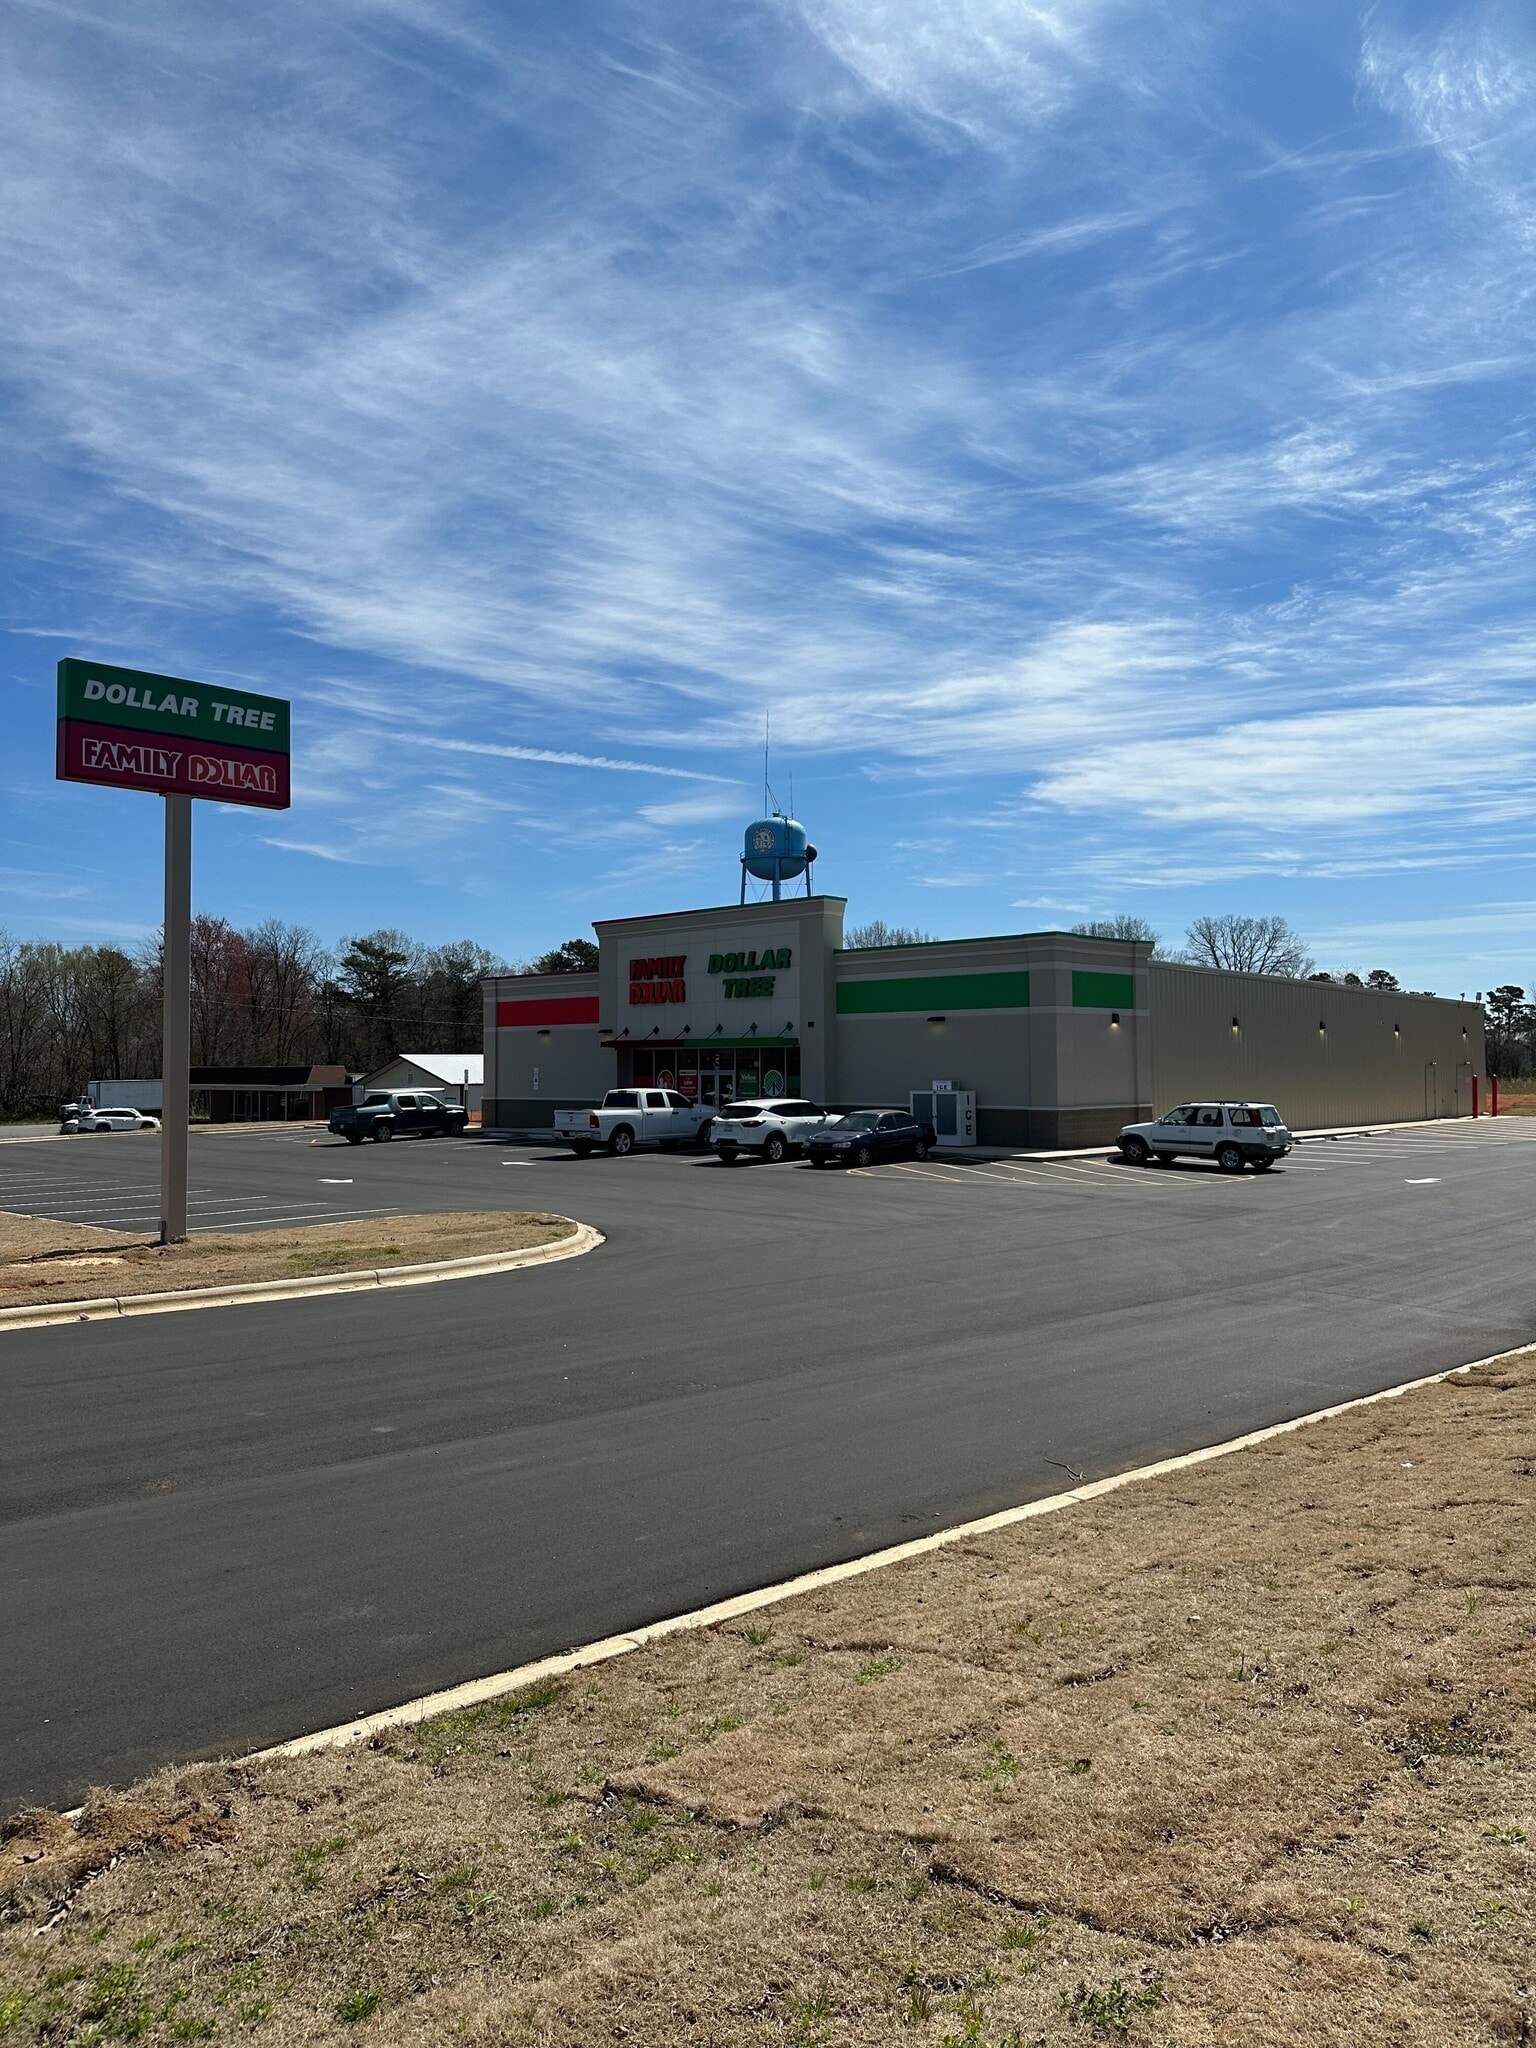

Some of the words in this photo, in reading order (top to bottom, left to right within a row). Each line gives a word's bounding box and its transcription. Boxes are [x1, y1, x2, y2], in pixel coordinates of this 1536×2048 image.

[83, 679, 199, 717] DOLLAR
[211, 701, 276, 731] TREE
[82, 738, 182, 779] FAMILY
[188, 754, 277, 793] DOLLAR
[630, 956, 686, 980] FAMILY
[708, 949, 792, 973] DOLLAR
[630, 979, 686, 1004] DOLLAR
[722, 975, 776, 998] TREE
